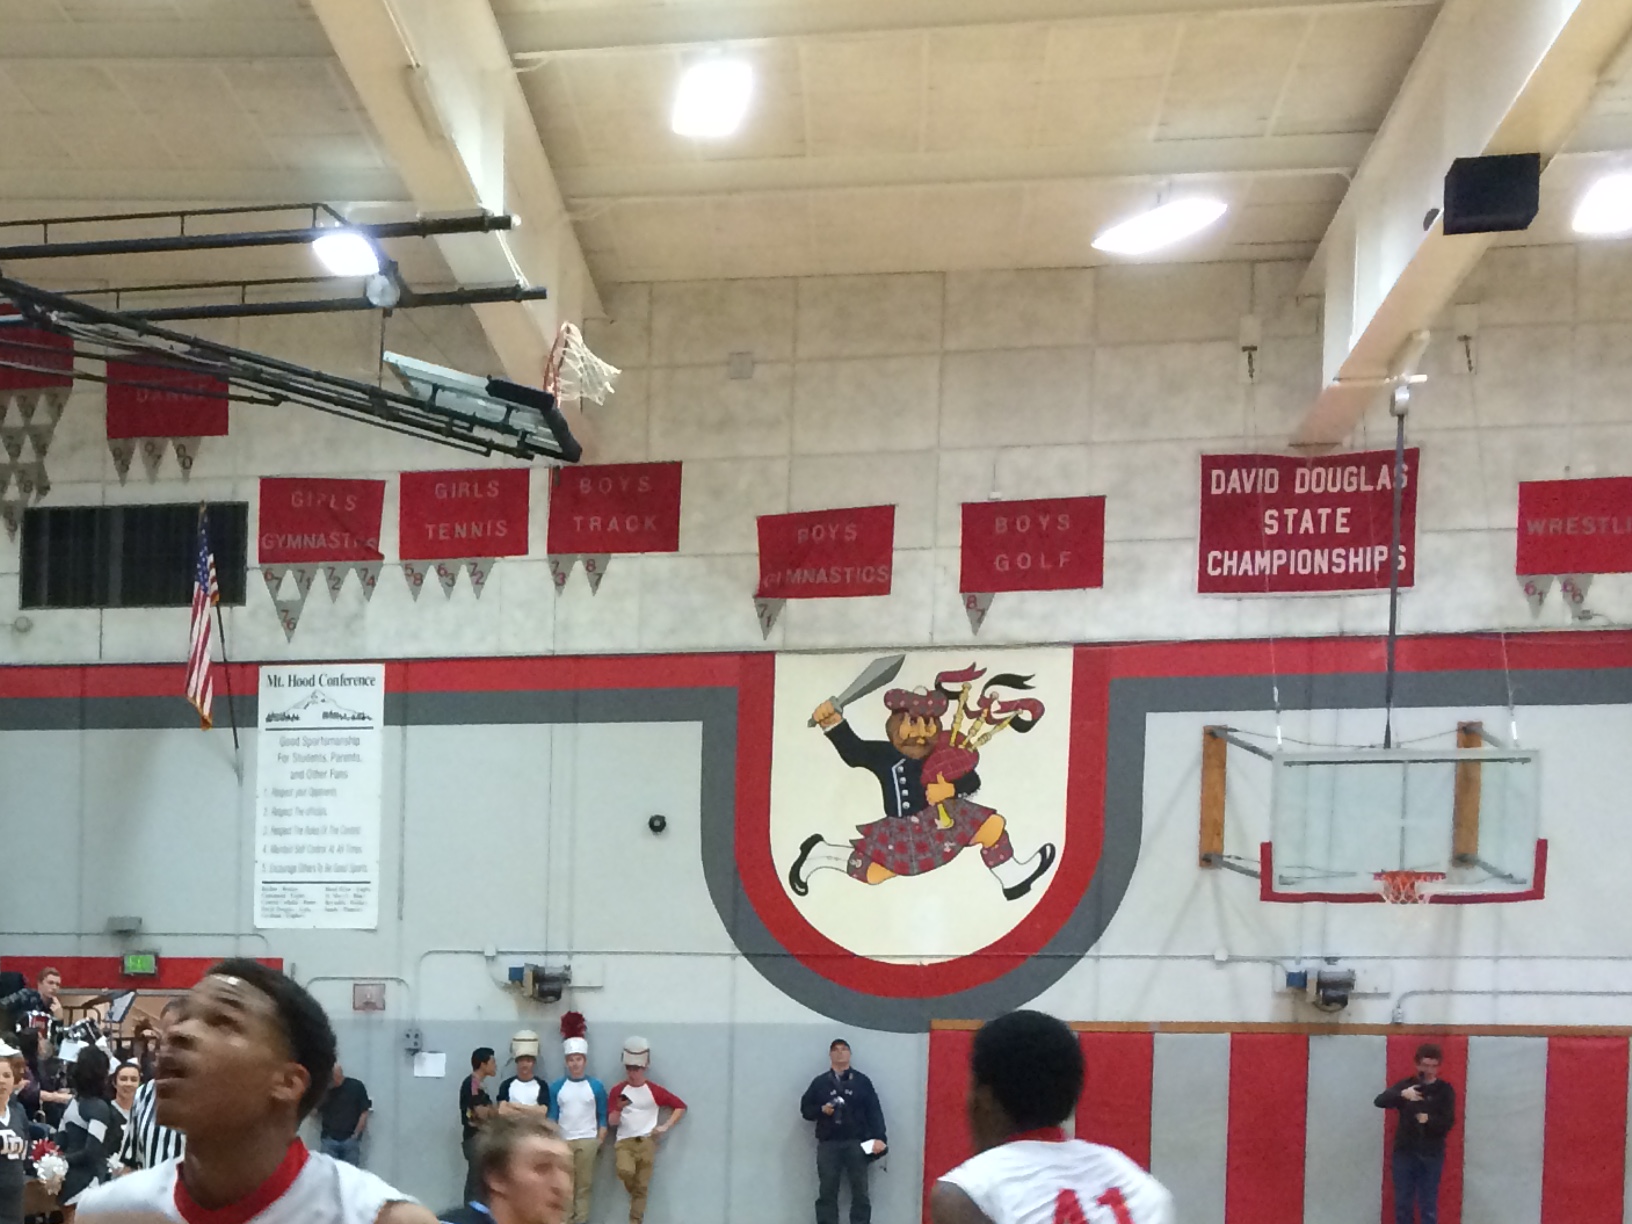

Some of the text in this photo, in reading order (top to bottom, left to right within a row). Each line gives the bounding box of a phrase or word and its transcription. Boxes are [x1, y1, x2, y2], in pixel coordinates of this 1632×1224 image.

[434, 480, 500, 499] GIRLS
[579, 476, 652, 495] BOYS
[1210, 464, 1408, 495] DAVID DOUGLAS
[425, 519, 509, 540] TENNIS
[573, 514, 658, 533] TRACK
[994, 513, 1071, 534] BOYS
[1264, 507, 1351, 535] STATE
[797, 523, 858, 544] BOYS
[993, 551, 1072, 572] GOLF
[1206, 545, 1407, 576] CHAMPIONSHIPS
[267, 673, 376, 688] Mt. Hood Conference
